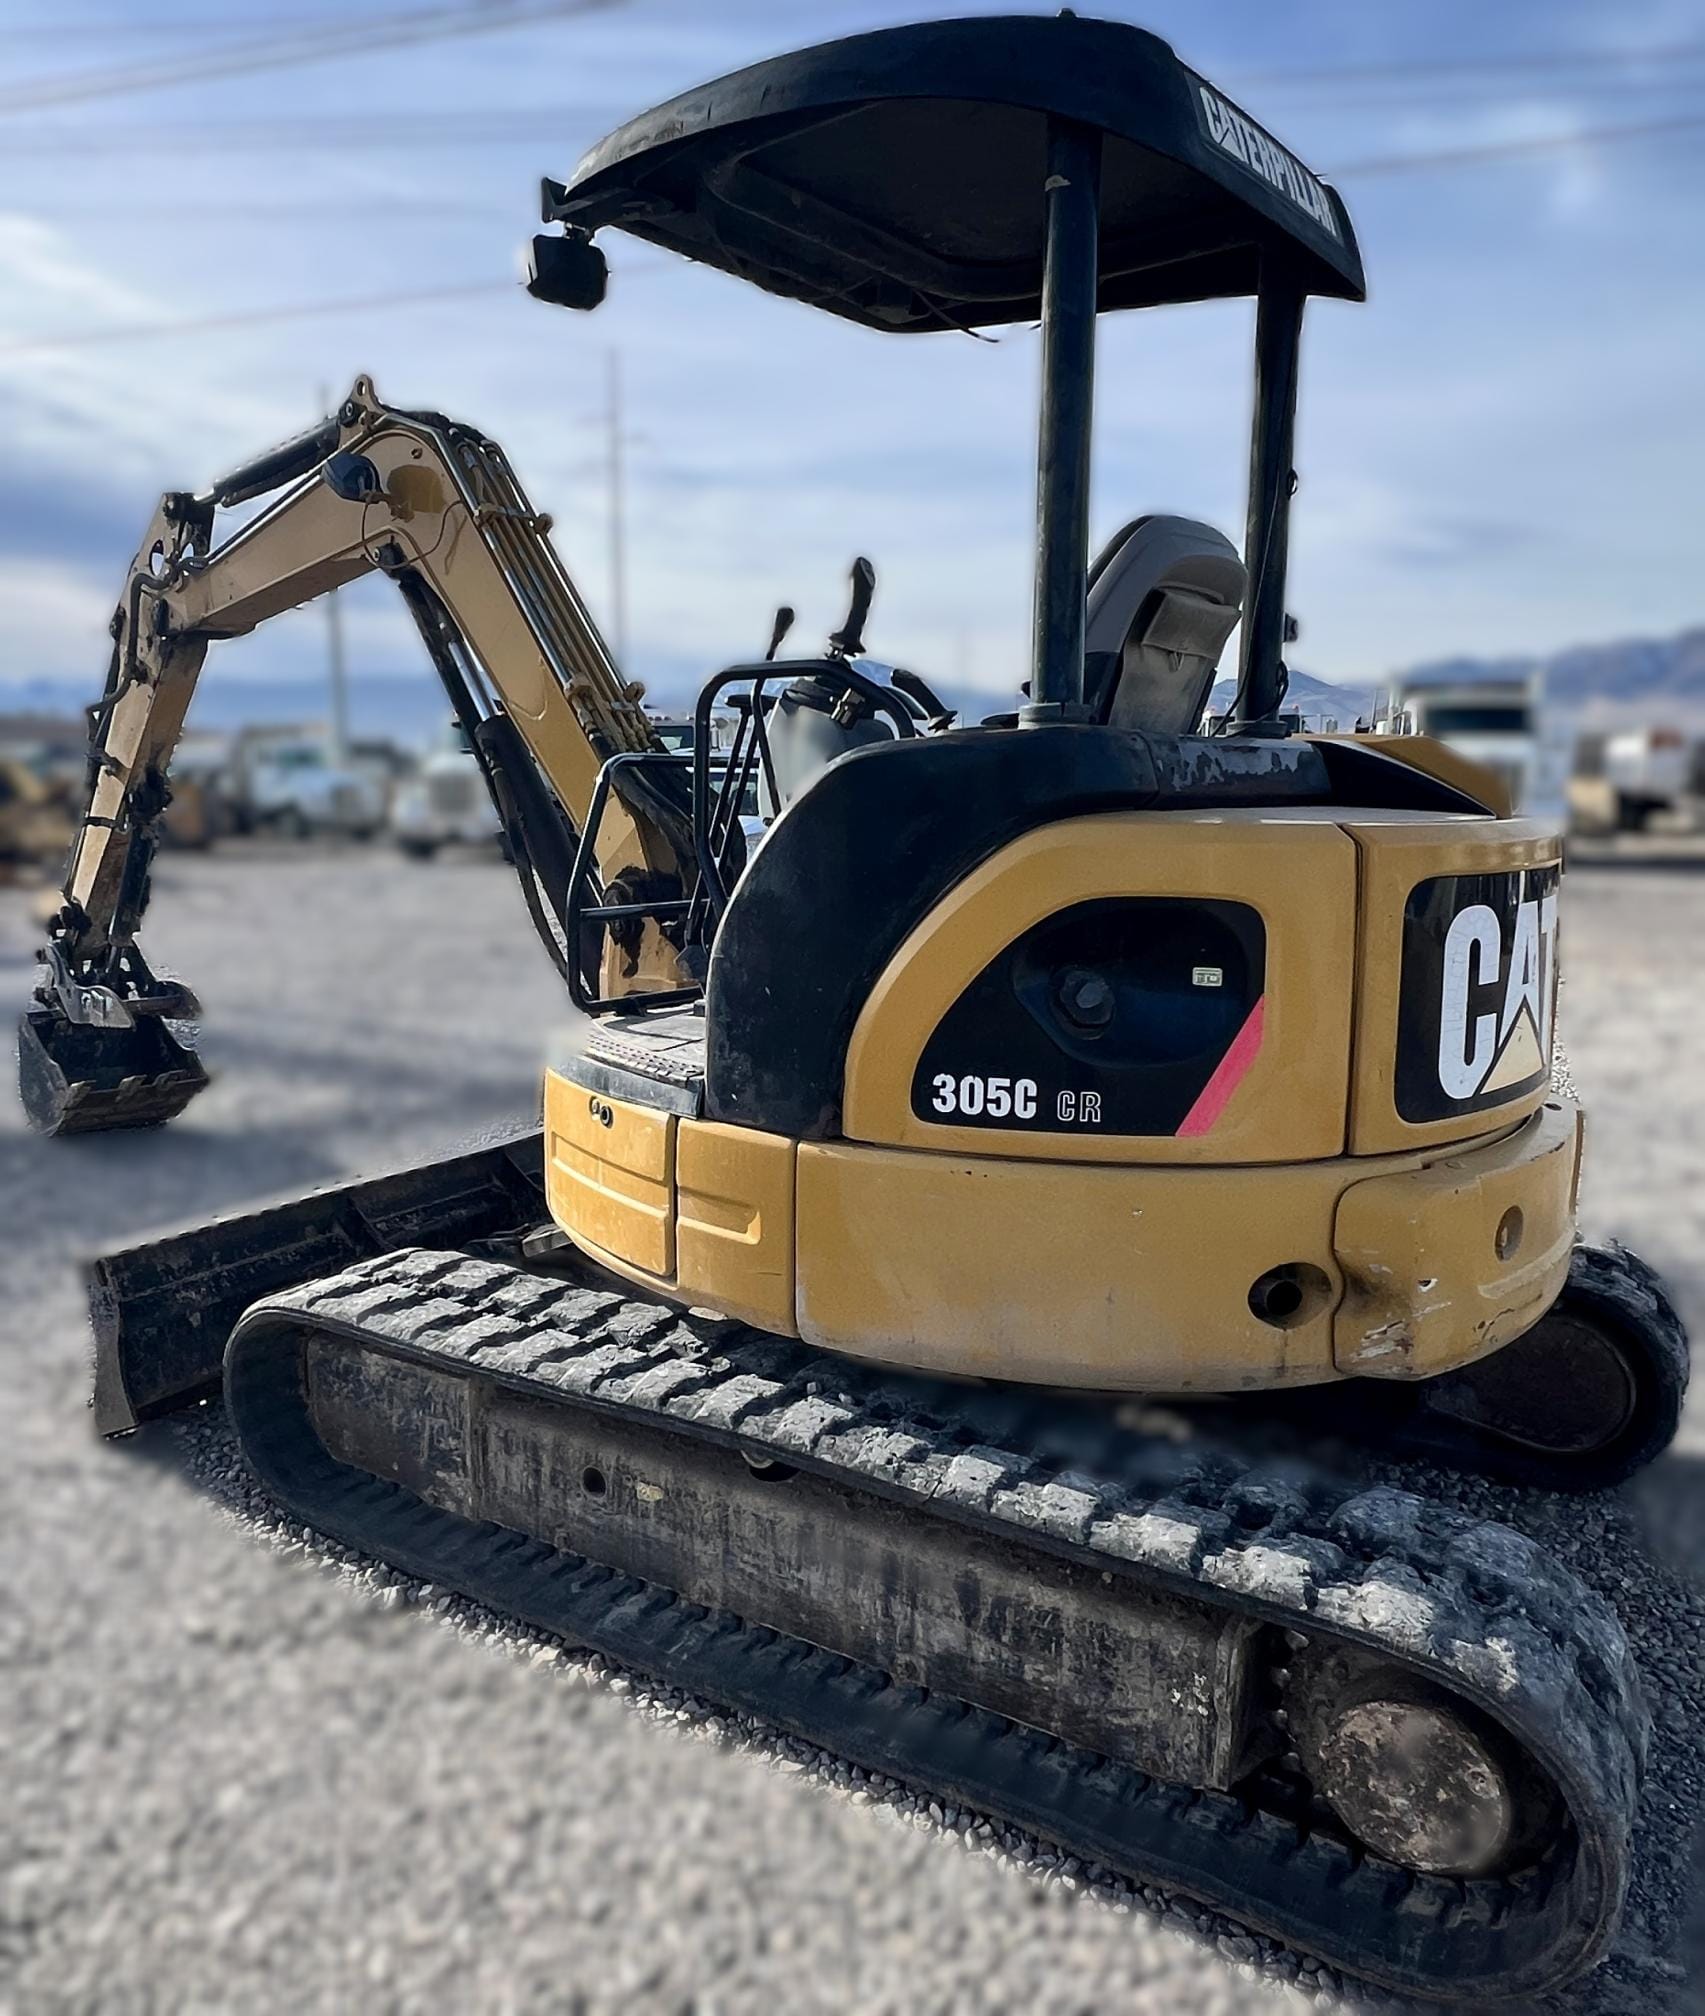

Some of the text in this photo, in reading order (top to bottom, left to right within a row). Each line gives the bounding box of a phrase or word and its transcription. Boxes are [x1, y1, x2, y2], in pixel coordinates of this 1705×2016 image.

[1200, 87, 1337, 237] CATERPILLAR
[1438, 895, 1558, 1100] CAT
[932, 1073, 1102, 1123] 305C CR
